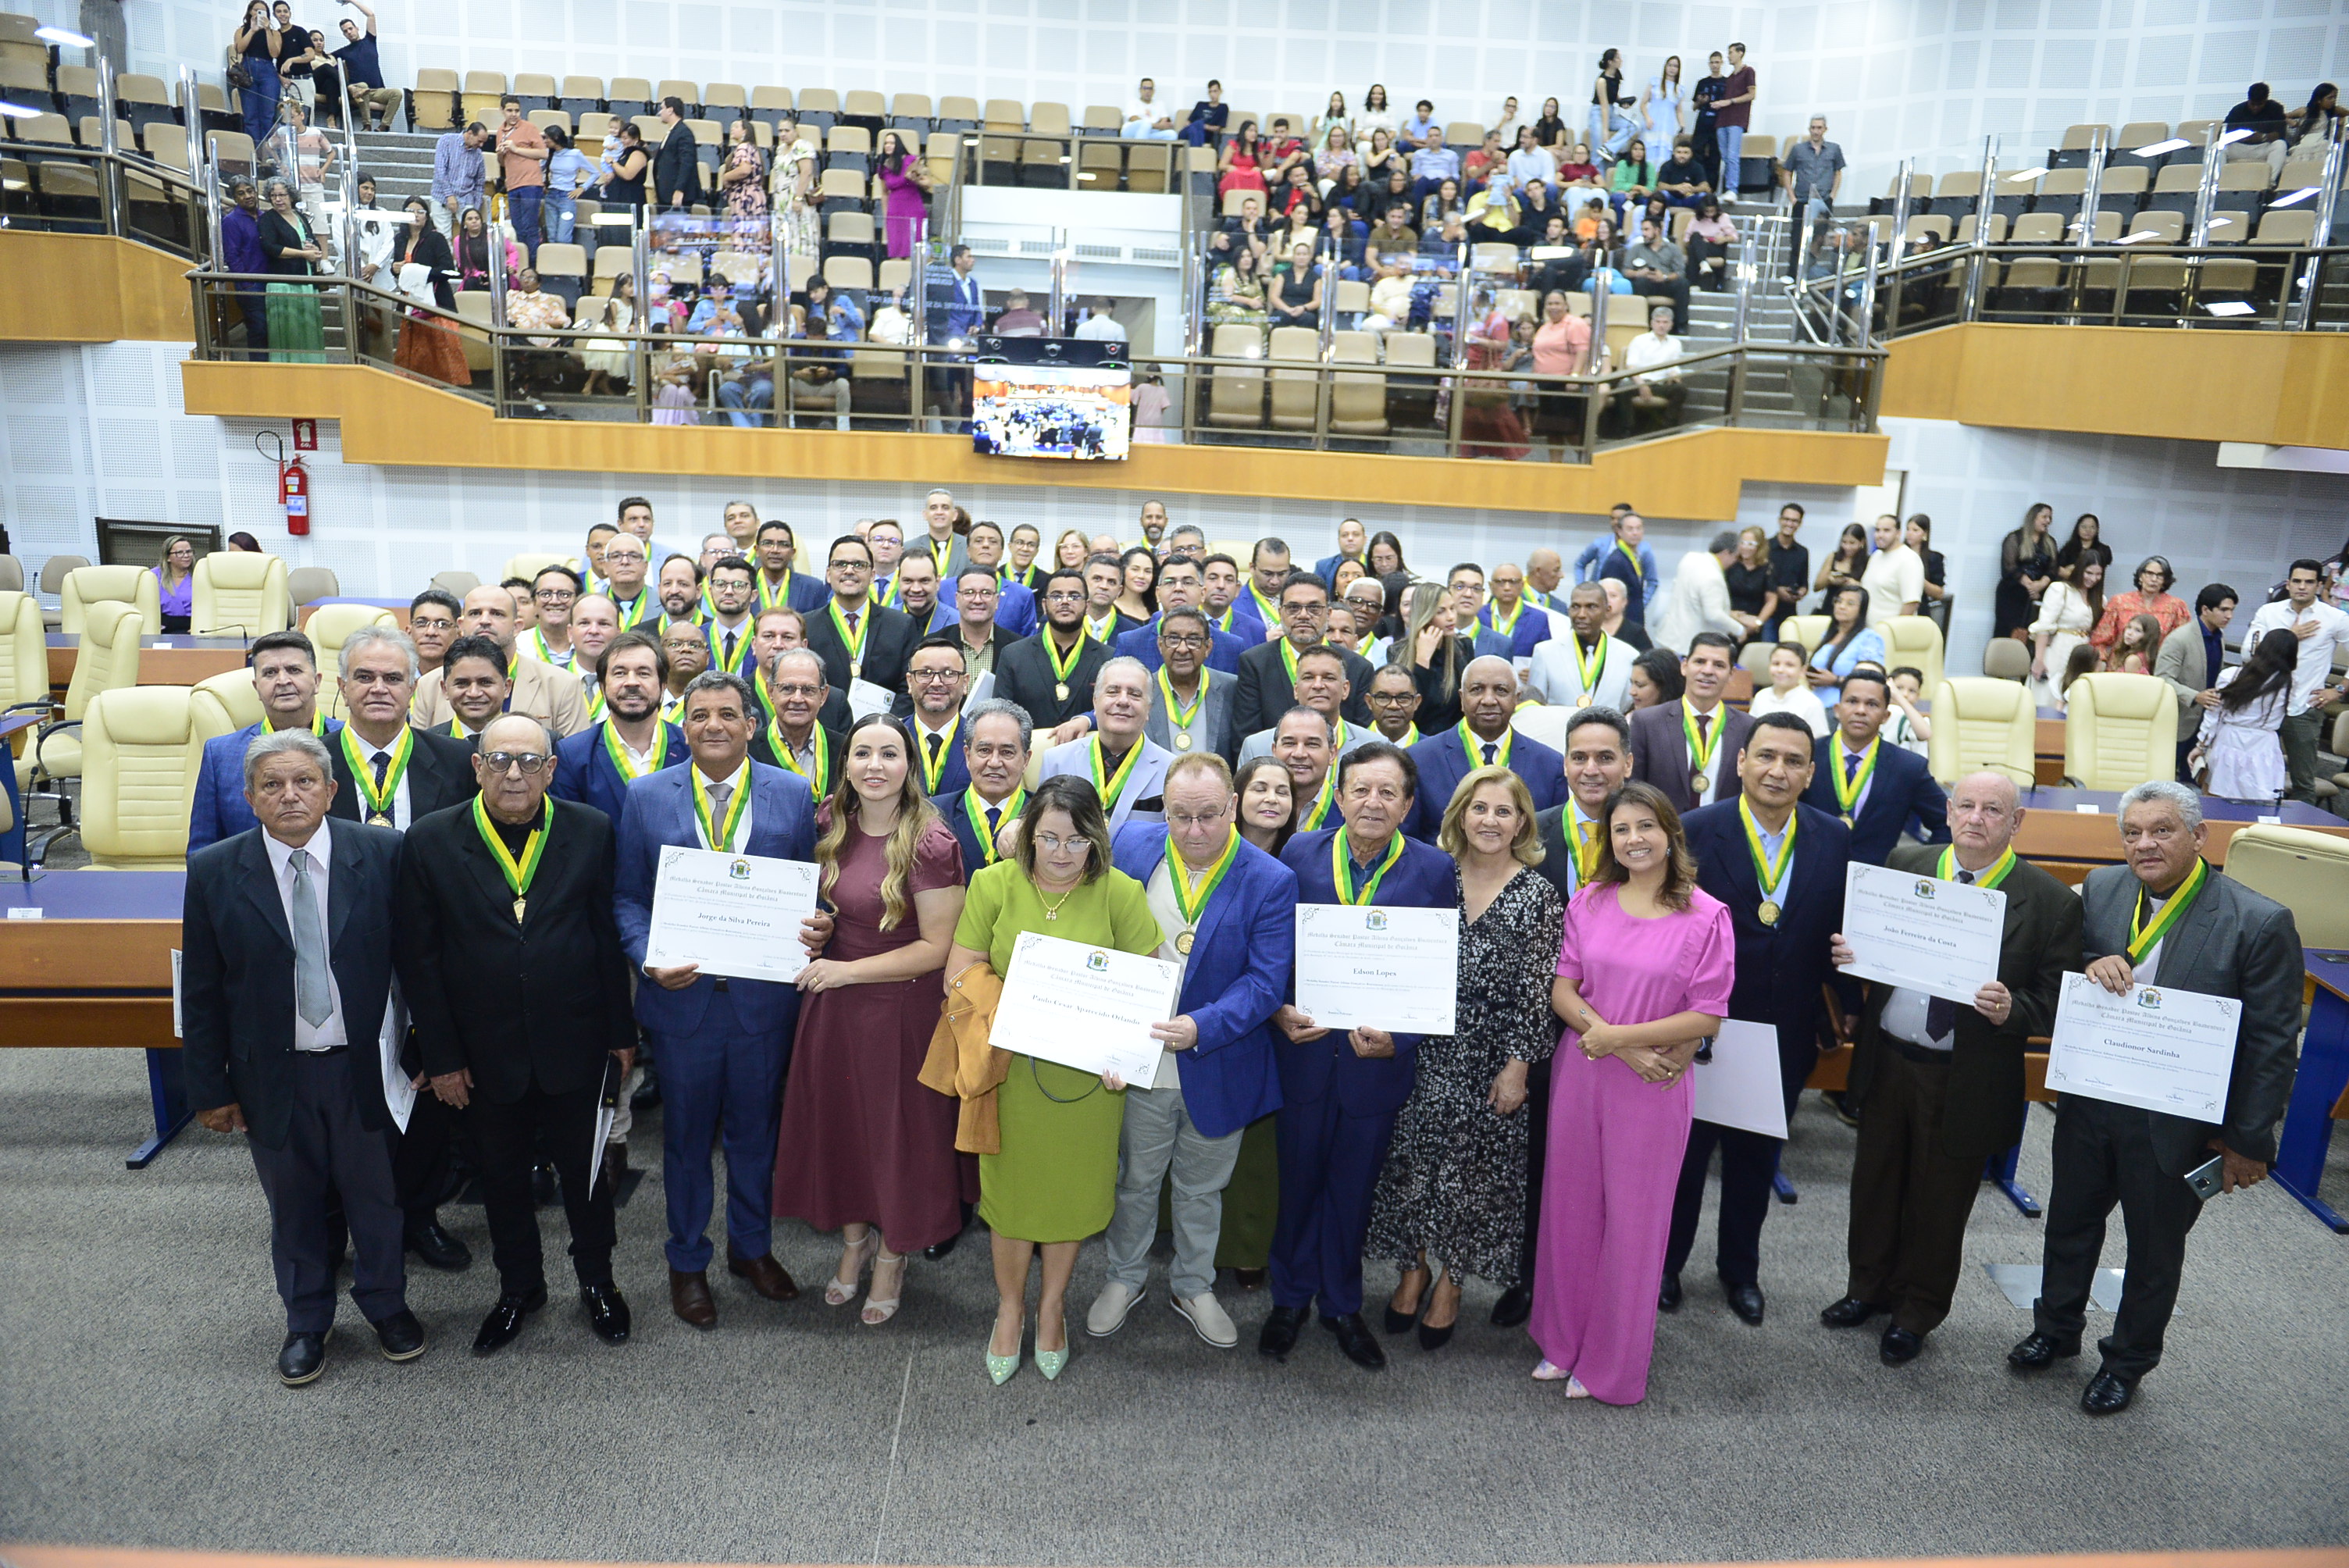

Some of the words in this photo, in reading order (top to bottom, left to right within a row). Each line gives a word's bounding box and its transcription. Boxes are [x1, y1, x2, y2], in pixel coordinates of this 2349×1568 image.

[698, 913, 717, 921] Jorge
[747, 918, 770, 927] Pereira
[1901, 929, 1927, 940] Ferreira
[1937, 938, 1957, 948] Costa
[1376, 969, 1397, 978] Lopes
[2104, 1039, 2145, 1052] Claudionor
[2147, 1047, 2180, 1058] Sardinha
